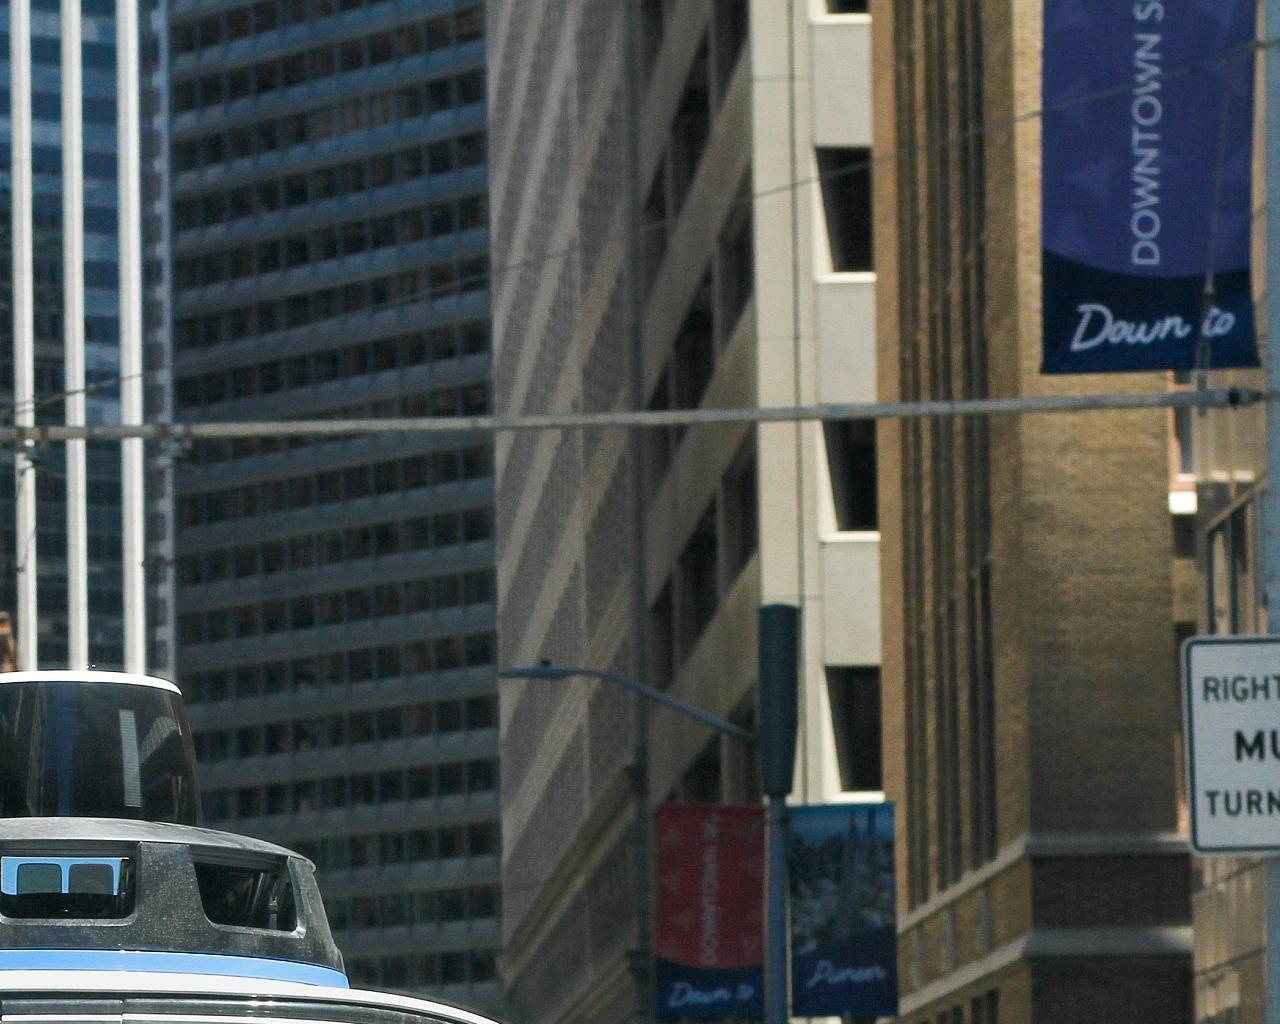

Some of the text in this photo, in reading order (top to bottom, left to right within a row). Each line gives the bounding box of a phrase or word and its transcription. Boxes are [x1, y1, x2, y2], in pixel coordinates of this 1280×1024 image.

[1131, 33, 1164, 265] DOWNTOWN
[1071, 303, 1235, 351] Down to
[1204, 789, 1280, 817] TURN
